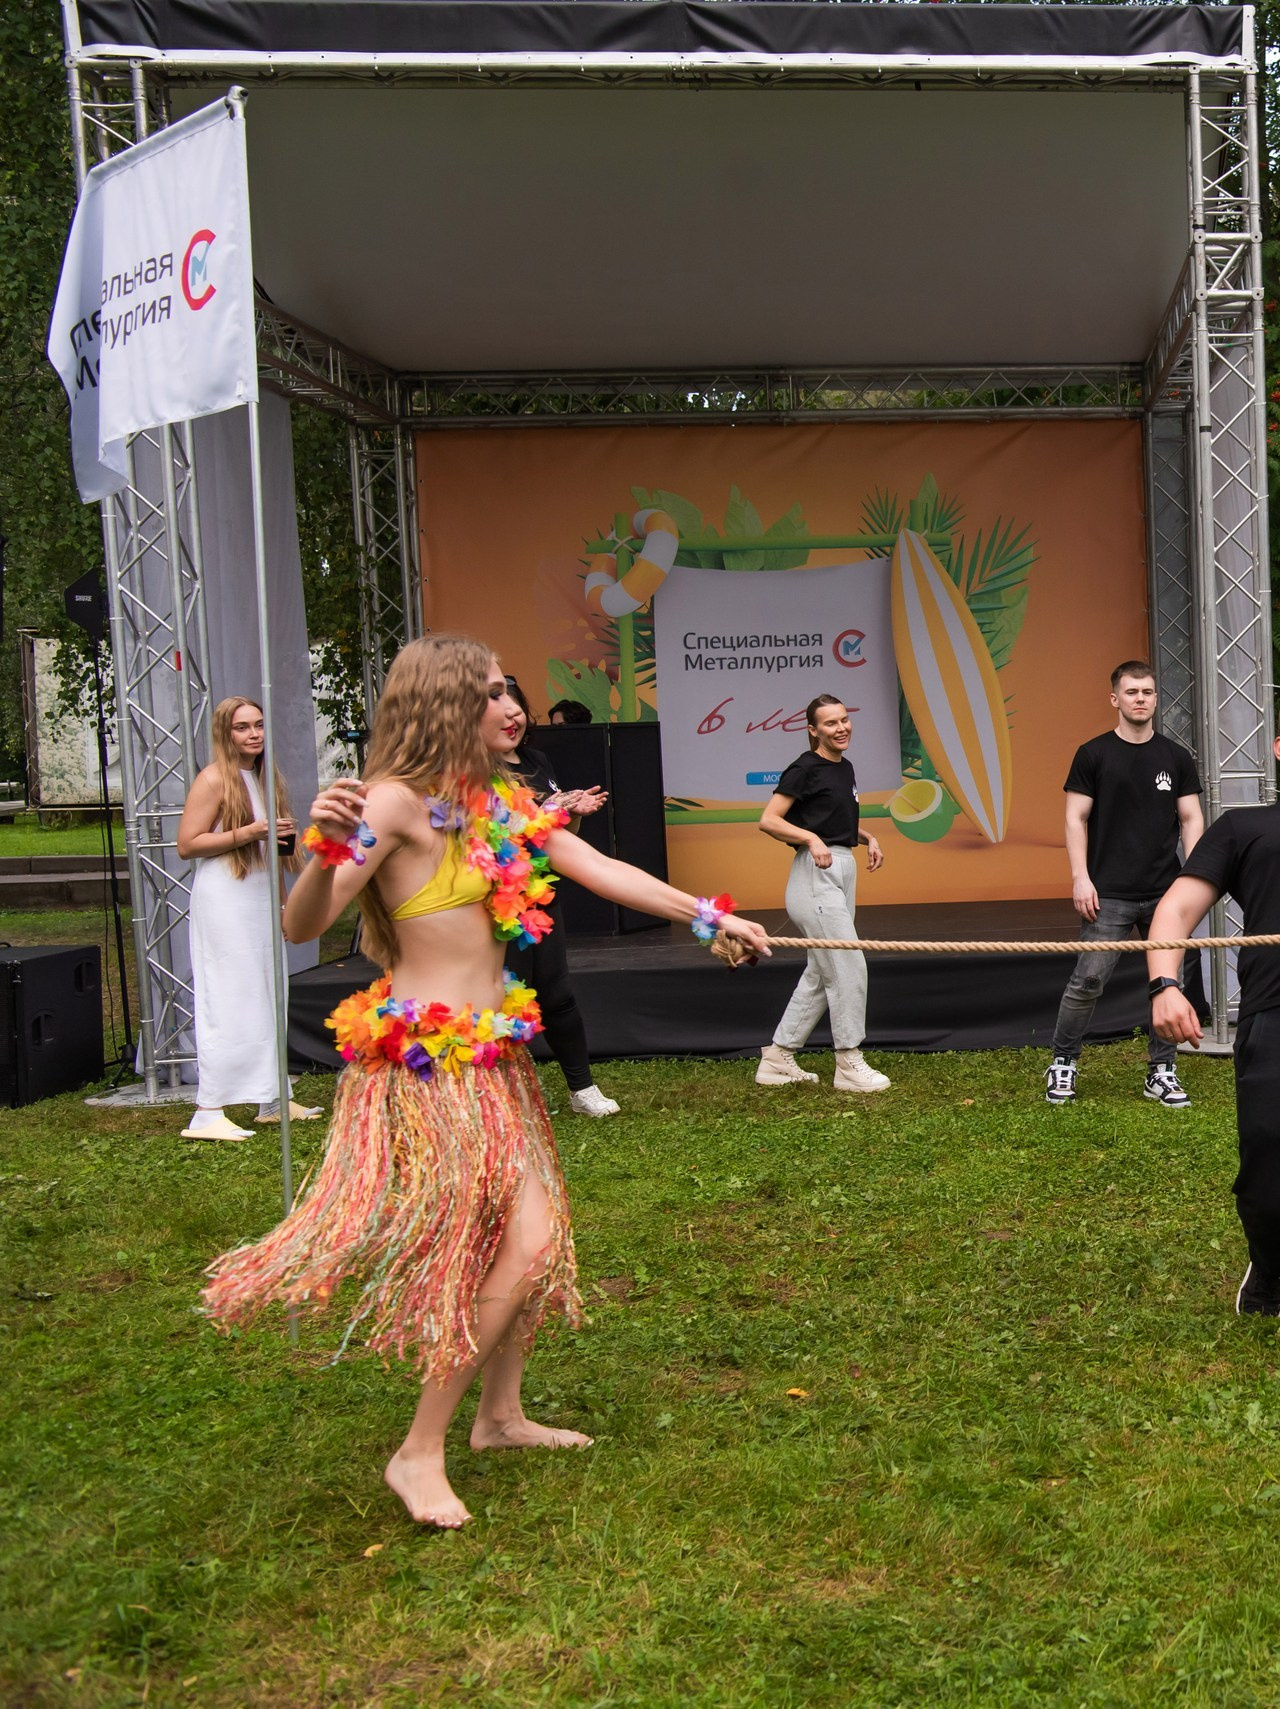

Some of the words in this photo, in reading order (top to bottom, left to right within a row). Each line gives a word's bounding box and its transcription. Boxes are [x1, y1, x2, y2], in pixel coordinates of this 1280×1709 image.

[683, 631, 823, 651] Специальная
[684, 653, 824, 673] Металлургия
[697, 697, 734, 735] 6
[746, 707, 860, 734] ле
